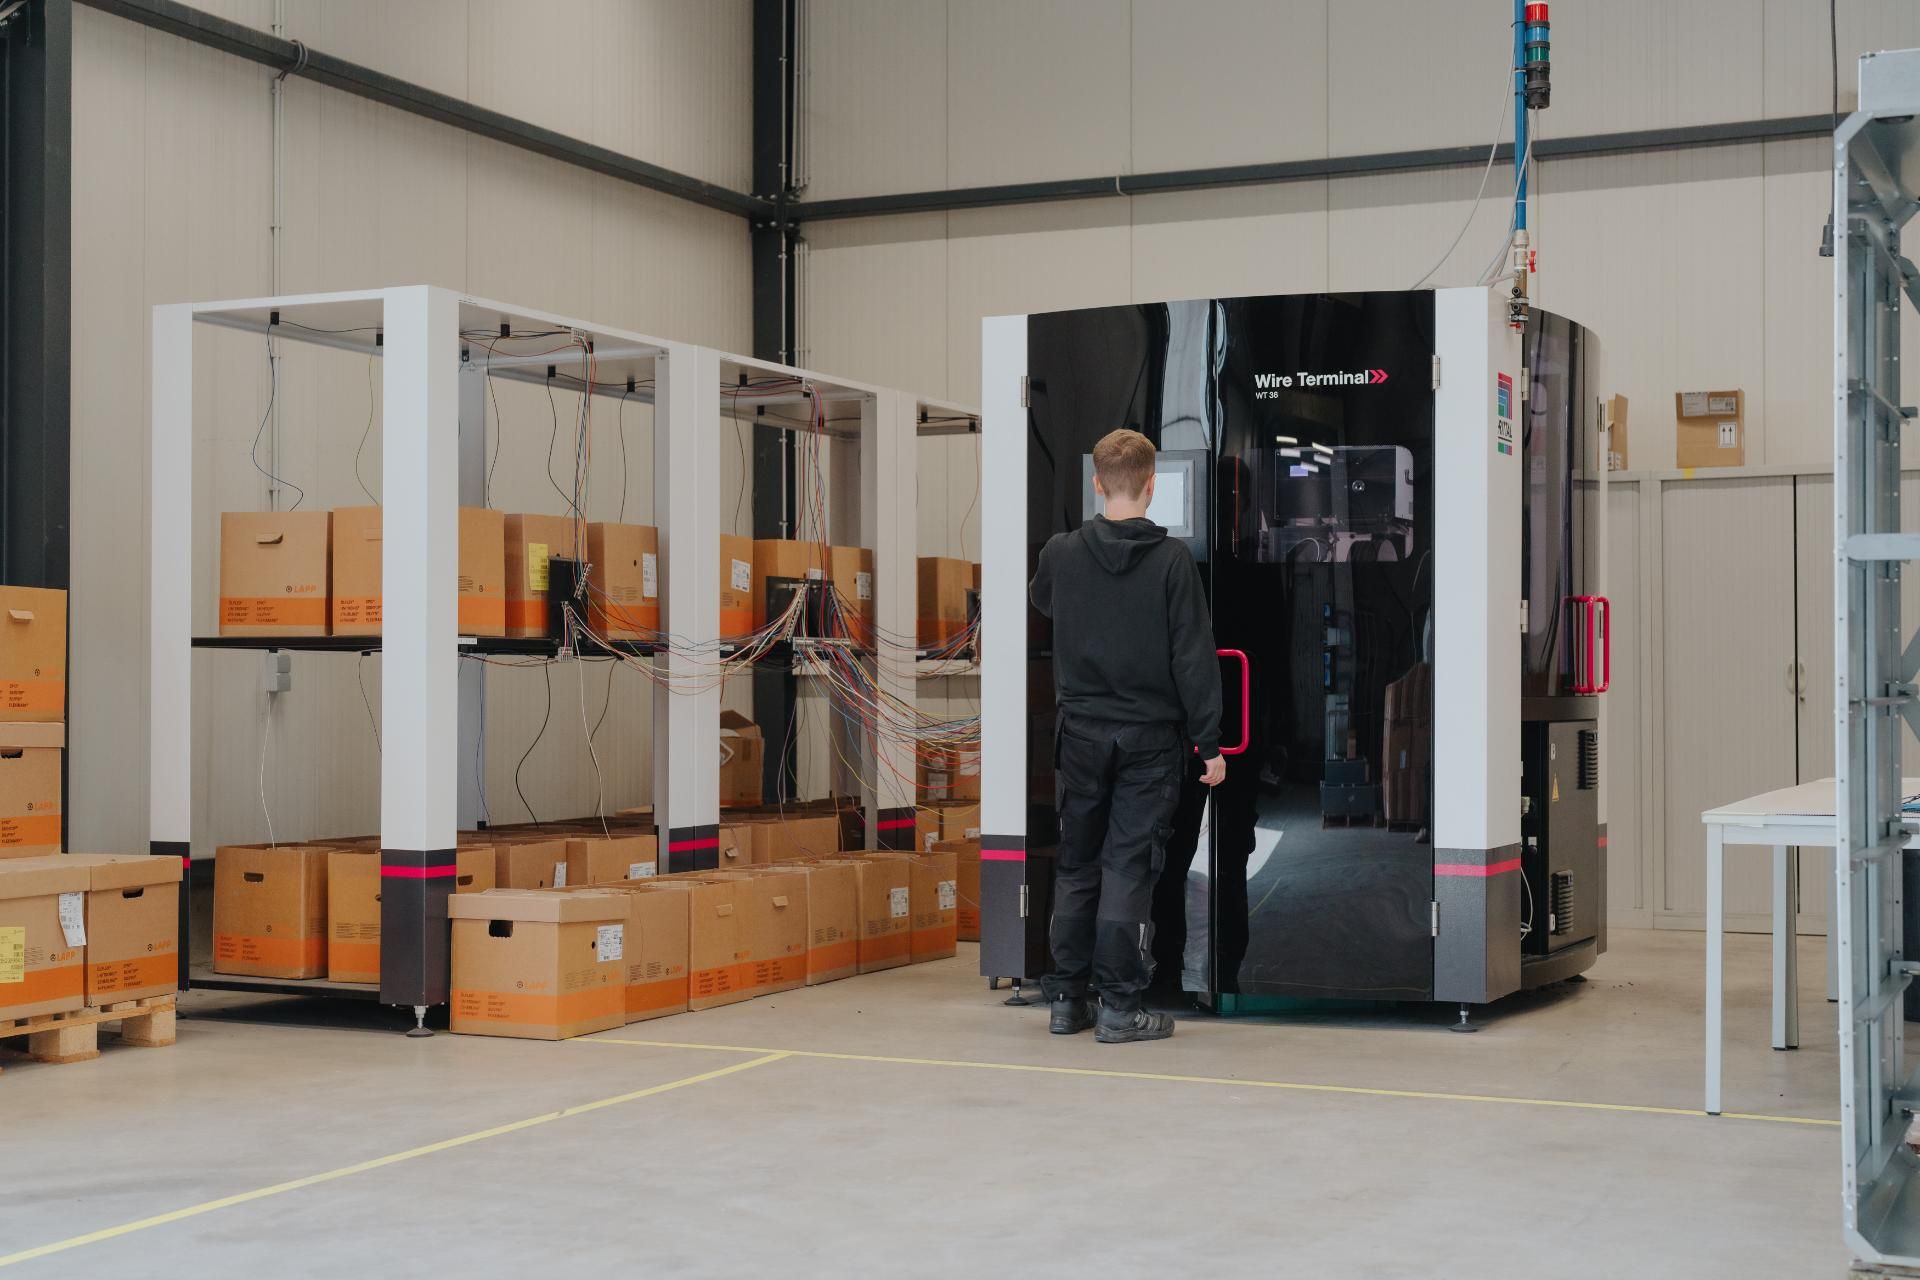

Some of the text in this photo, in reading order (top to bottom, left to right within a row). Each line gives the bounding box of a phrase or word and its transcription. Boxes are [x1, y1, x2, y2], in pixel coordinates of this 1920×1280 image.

[1255, 370, 1369, 388] Wire Terminal
[1255, 391, 1279, 400] WT 36
[294, 584, 317, 593] LAPP
[57, 950, 76, 962] LAPP
